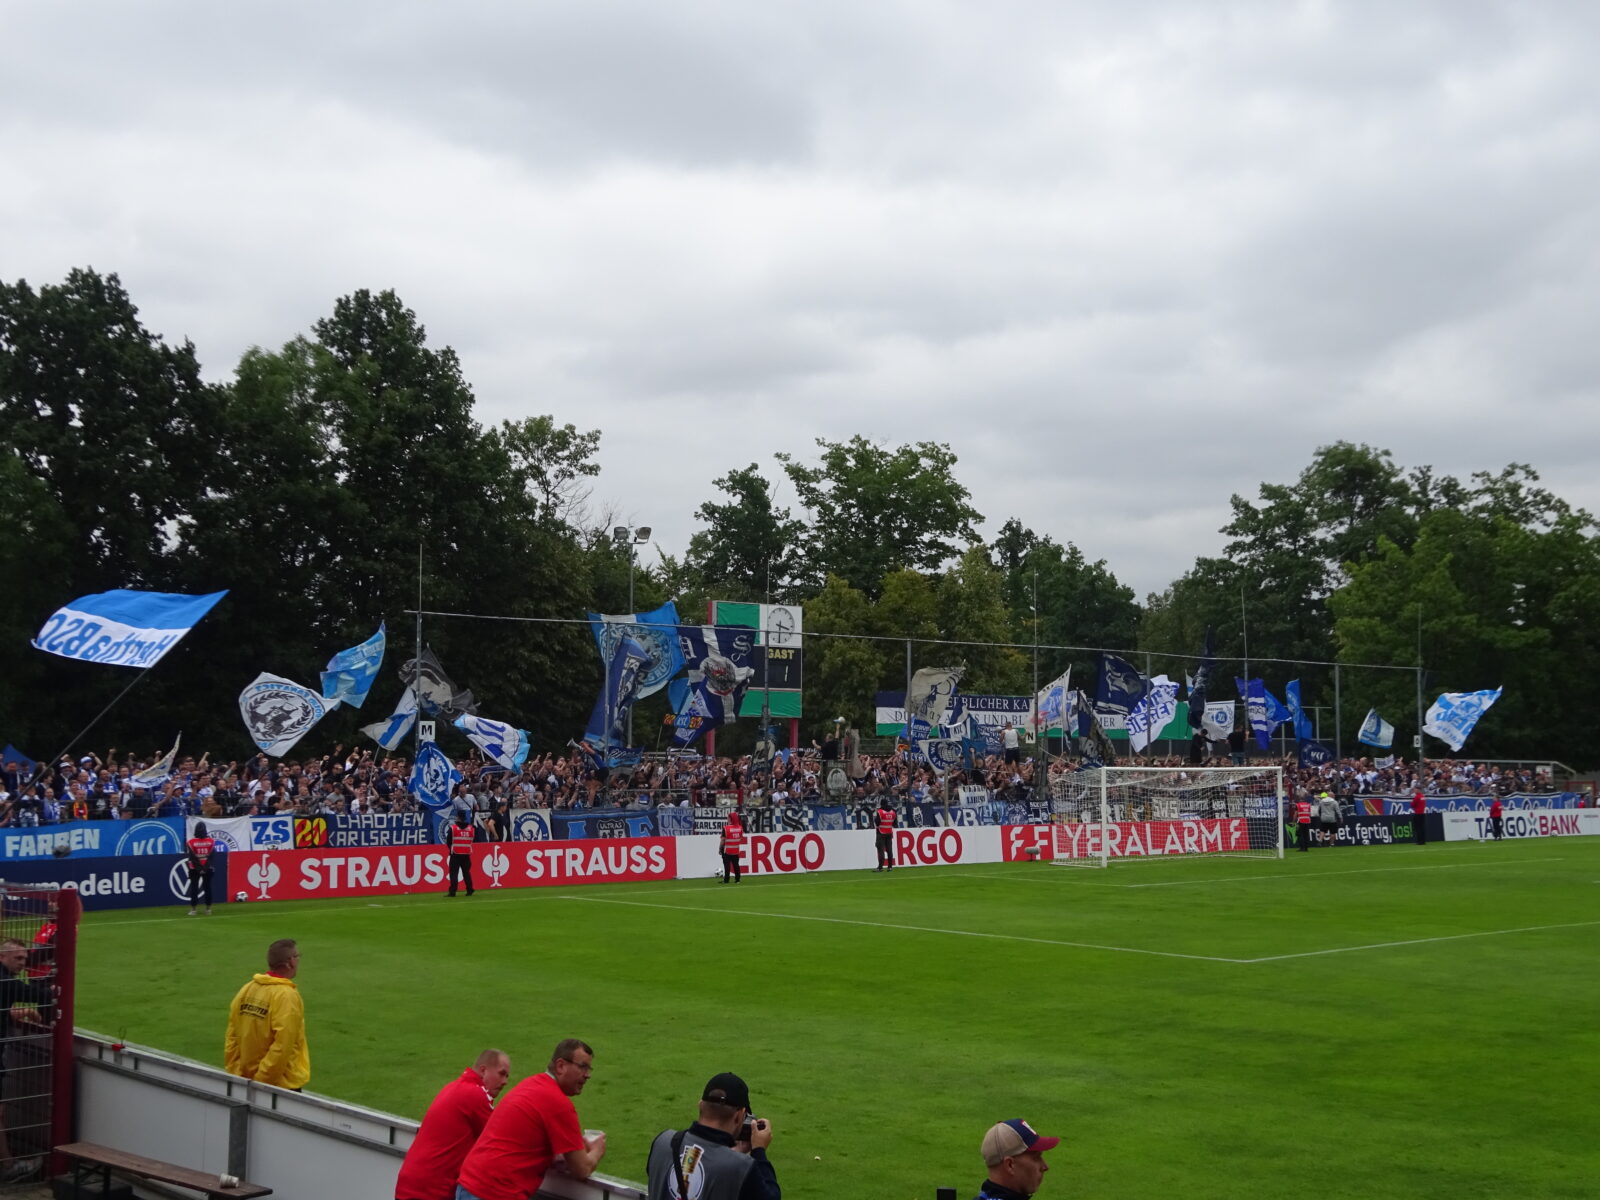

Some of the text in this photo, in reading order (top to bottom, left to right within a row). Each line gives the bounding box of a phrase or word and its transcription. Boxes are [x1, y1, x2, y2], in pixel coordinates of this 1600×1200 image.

[421, 725, 433, 735] M
[1027, 733, 1034, 741] N
[336, 813, 424, 829] CHAOTEN
[661, 815, 693, 829] UNS
[1355, 822, 1392, 843] fertig,
[1392, 821, 1414, 838] los!
[5, 828, 101, 857] FARBEN
[328, 829, 428, 847] KARLSRUHE
[883, 828, 963, 866] RGO
[1034, 820, 1224, 860] FLYERALARM
[299, 853, 463, 890] STRAUS
[526, 844, 666, 879] STRAUSS
